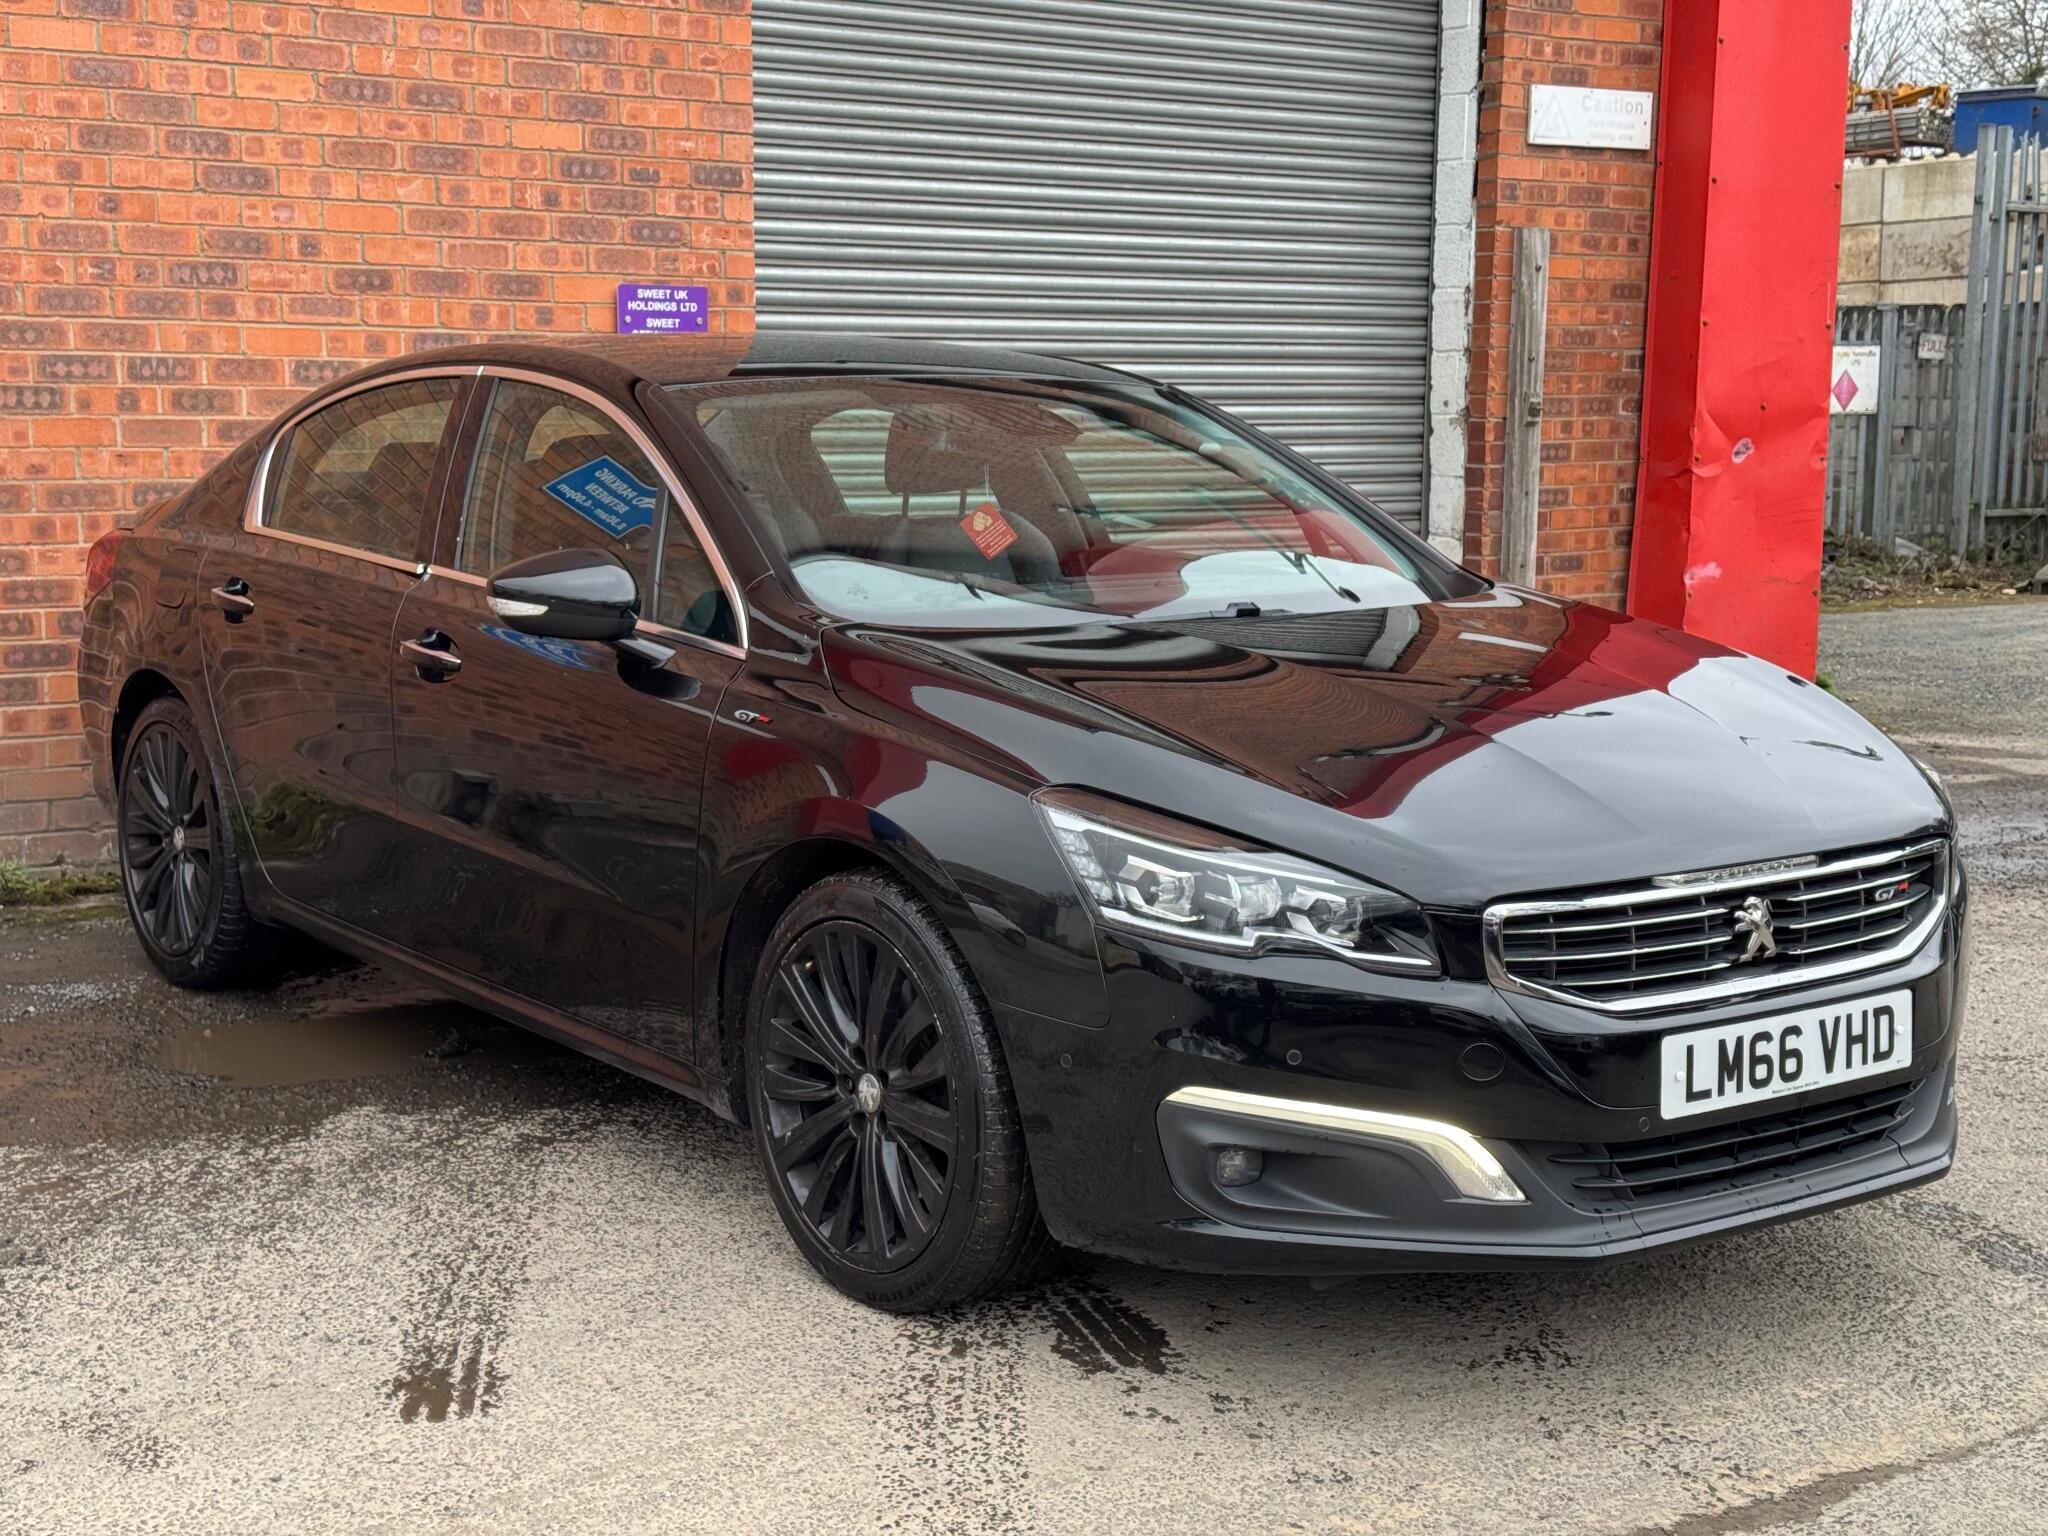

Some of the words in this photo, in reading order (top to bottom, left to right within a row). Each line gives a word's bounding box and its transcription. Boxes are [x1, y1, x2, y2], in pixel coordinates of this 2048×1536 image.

[1582, 94, 1644, 115] Caution
[637, 288, 671, 300] SWEET
[674, 290, 688, 300] UK
[627, 301, 677, 311] HOLDINGS
[680, 303, 698, 313] LTD
[645, 318, 681, 329] SWEET
[1685, 1024, 1804, 1104] LM66
[1819, 1004, 1895, 1075] VHD
